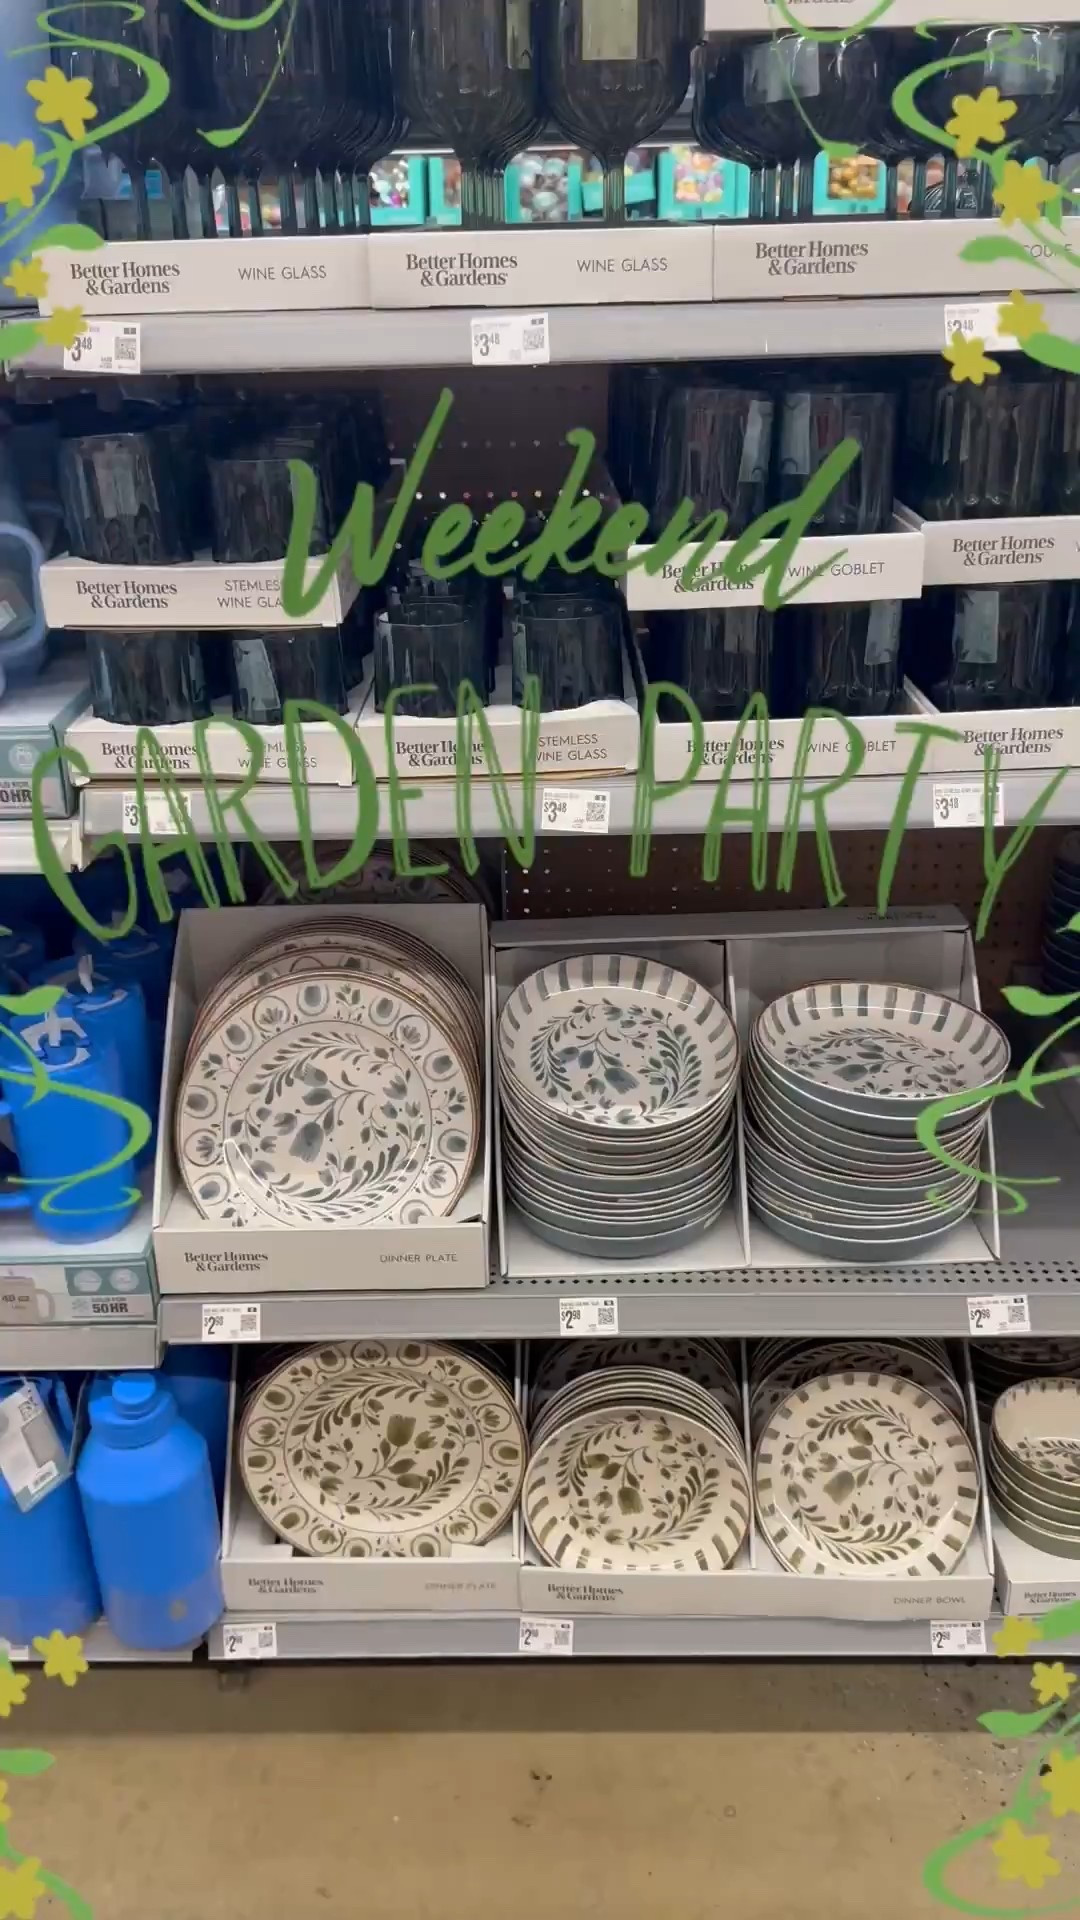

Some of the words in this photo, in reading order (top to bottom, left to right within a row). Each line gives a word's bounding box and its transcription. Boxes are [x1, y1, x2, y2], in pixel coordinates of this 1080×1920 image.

[756, 242, 806, 259] Better
[809, 240, 869, 257] Homes
[1023, 243, 1073, 258] OUE
[406, 254, 456, 270] Better
[459, 252, 518, 268] Homes
[577, 259, 615, 272] WINE
[621, 257, 668, 271] GLASS
[70, 262, 119, 280] Better
[122, 261, 181, 278] Homes
[238, 267, 275, 280] WINE
[281, 265, 327, 280] GLASS
[952, 538, 999, 553] Better
[1000, 536, 1056, 550] Homes
[662, 564, 709, 579] Beer
[830, 562, 885, 576] GOBLET
[76, 580, 122, 595] Better
[124, 580, 178, 595] Homes
[224, 579, 282, 592] STEMLES
[216, 596, 252, 608] WINE
[257, 596, 283, 608] GLA
[538, 733, 599, 747] STEMLESS
[964, 730, 1009, 743] Better
[1010, 727, 1064, 741] Homes
[101, 742, 140, 756] Bette
[158, 742, 198, 756] omes
[246, 741, 308, 753] SMLSS
[396, 741, 440, 755] Better
[441, 741, 484, 754] Hoe
[687, 738, 731, 753] Btter
[807, 742, 839, 753] WINE
[846, 740, 897, 753] BLET
[567, 748, 608, 761] GLASS
[238, 757, 271, 768] WE
[277, 757, 317, 769] GSS
[184, 1252, 222, 1262] Better
[224, 1251, 269, 1262] Homes
[380, 1253, 421, 1263] DINNER
[425, 1253, 458, 1262] PLATE
[893, 1597, 932, 1605] DINNER
[936, 1596, 966, 1604] BOWL
